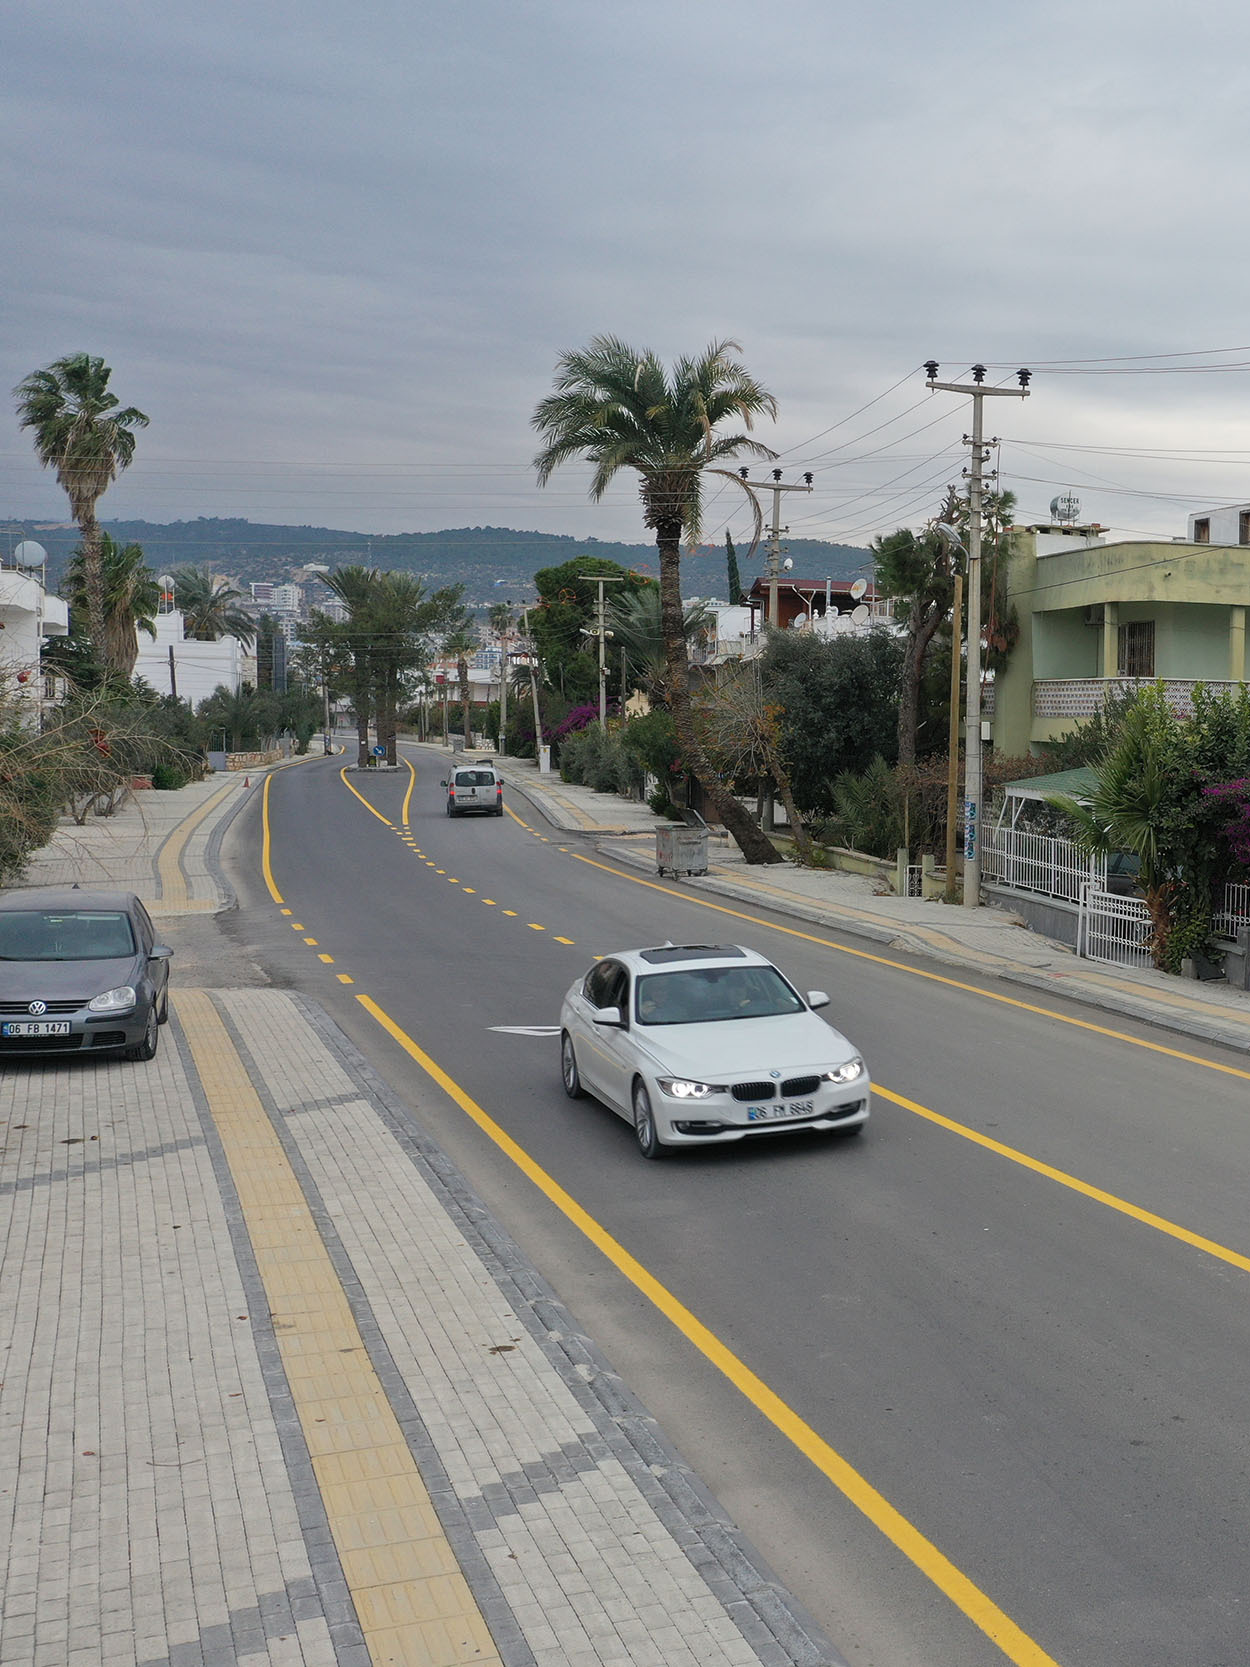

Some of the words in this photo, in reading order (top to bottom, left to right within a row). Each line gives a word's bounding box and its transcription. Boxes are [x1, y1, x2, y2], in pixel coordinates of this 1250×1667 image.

[9, 1024, 21, 1033] 06
[27, 1024, 40, 1033] FB
[45, 1023, 68, 1033] 1471
